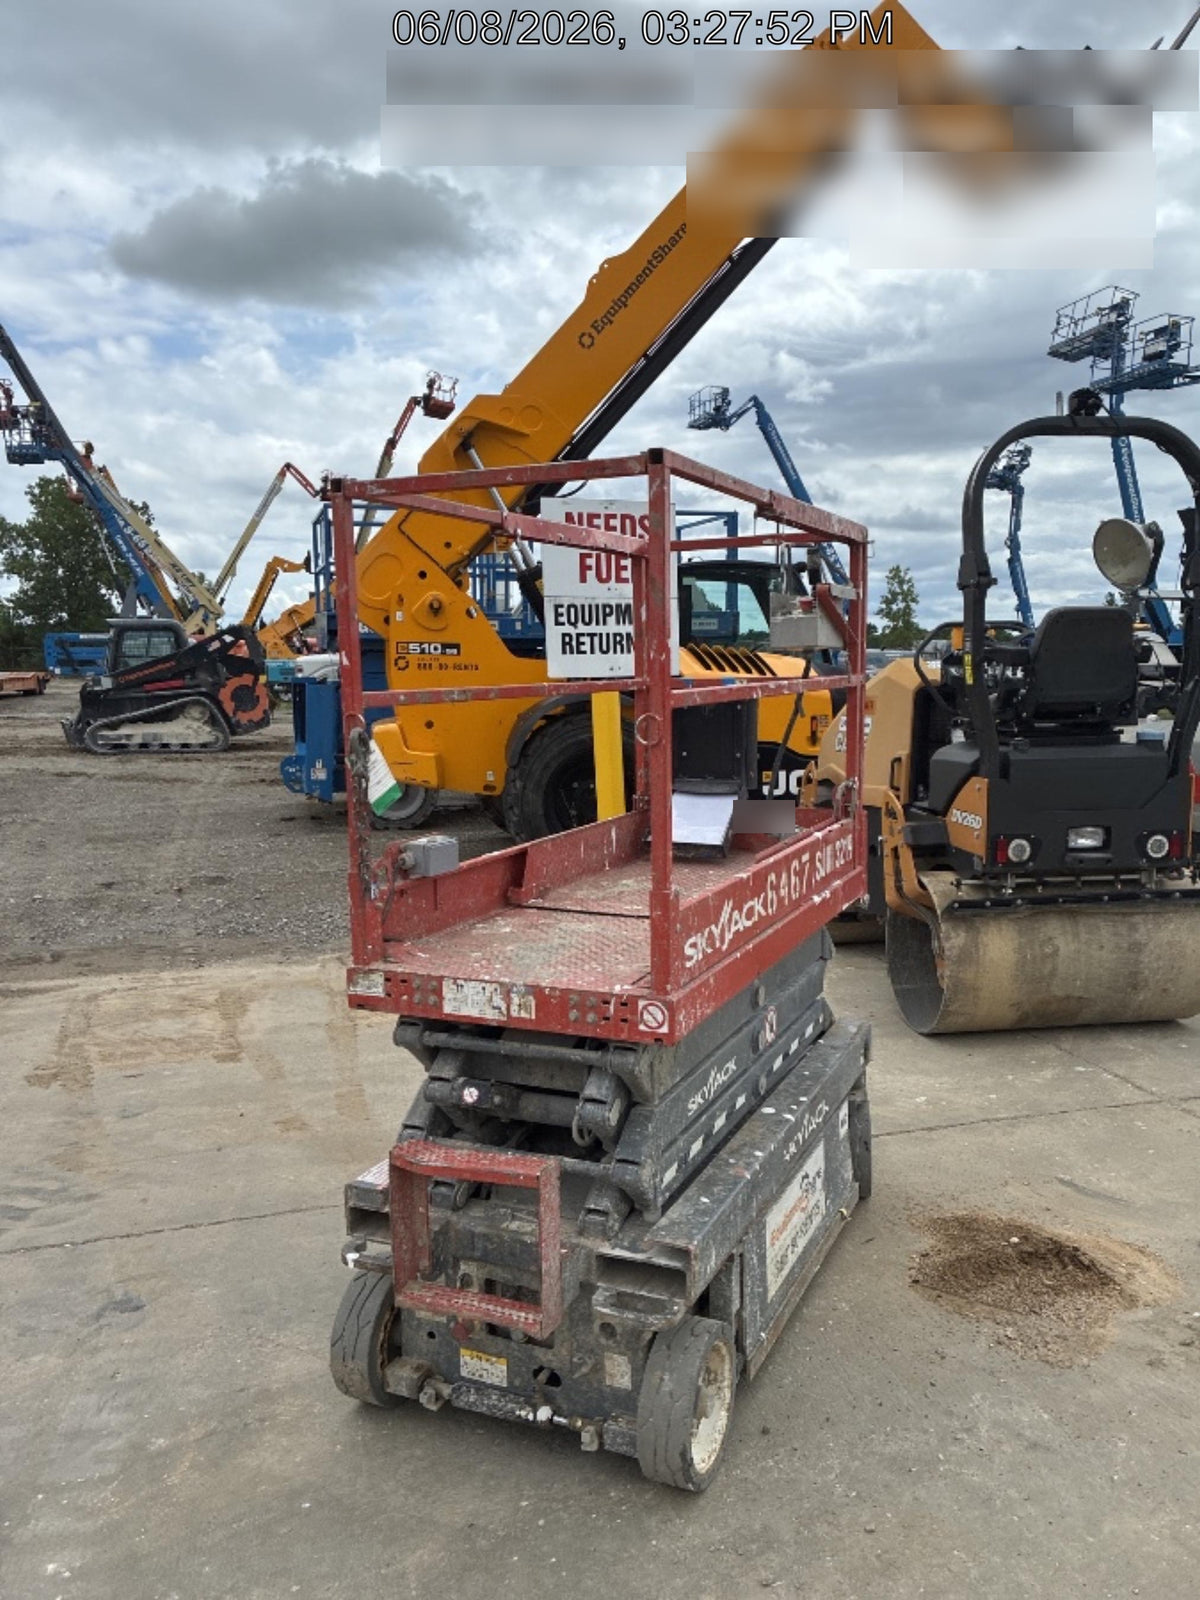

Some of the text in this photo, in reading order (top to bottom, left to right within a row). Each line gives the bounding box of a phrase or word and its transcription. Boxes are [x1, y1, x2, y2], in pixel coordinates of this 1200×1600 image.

[579, 553, 634, 583] FUE
[553, 603, 633, 629] EQUIPM
[762, 769, 806, 796] JC
[684, 891, 767, 968] SKYJACK
[687, 1056, 738, 1117] SKYJACK
